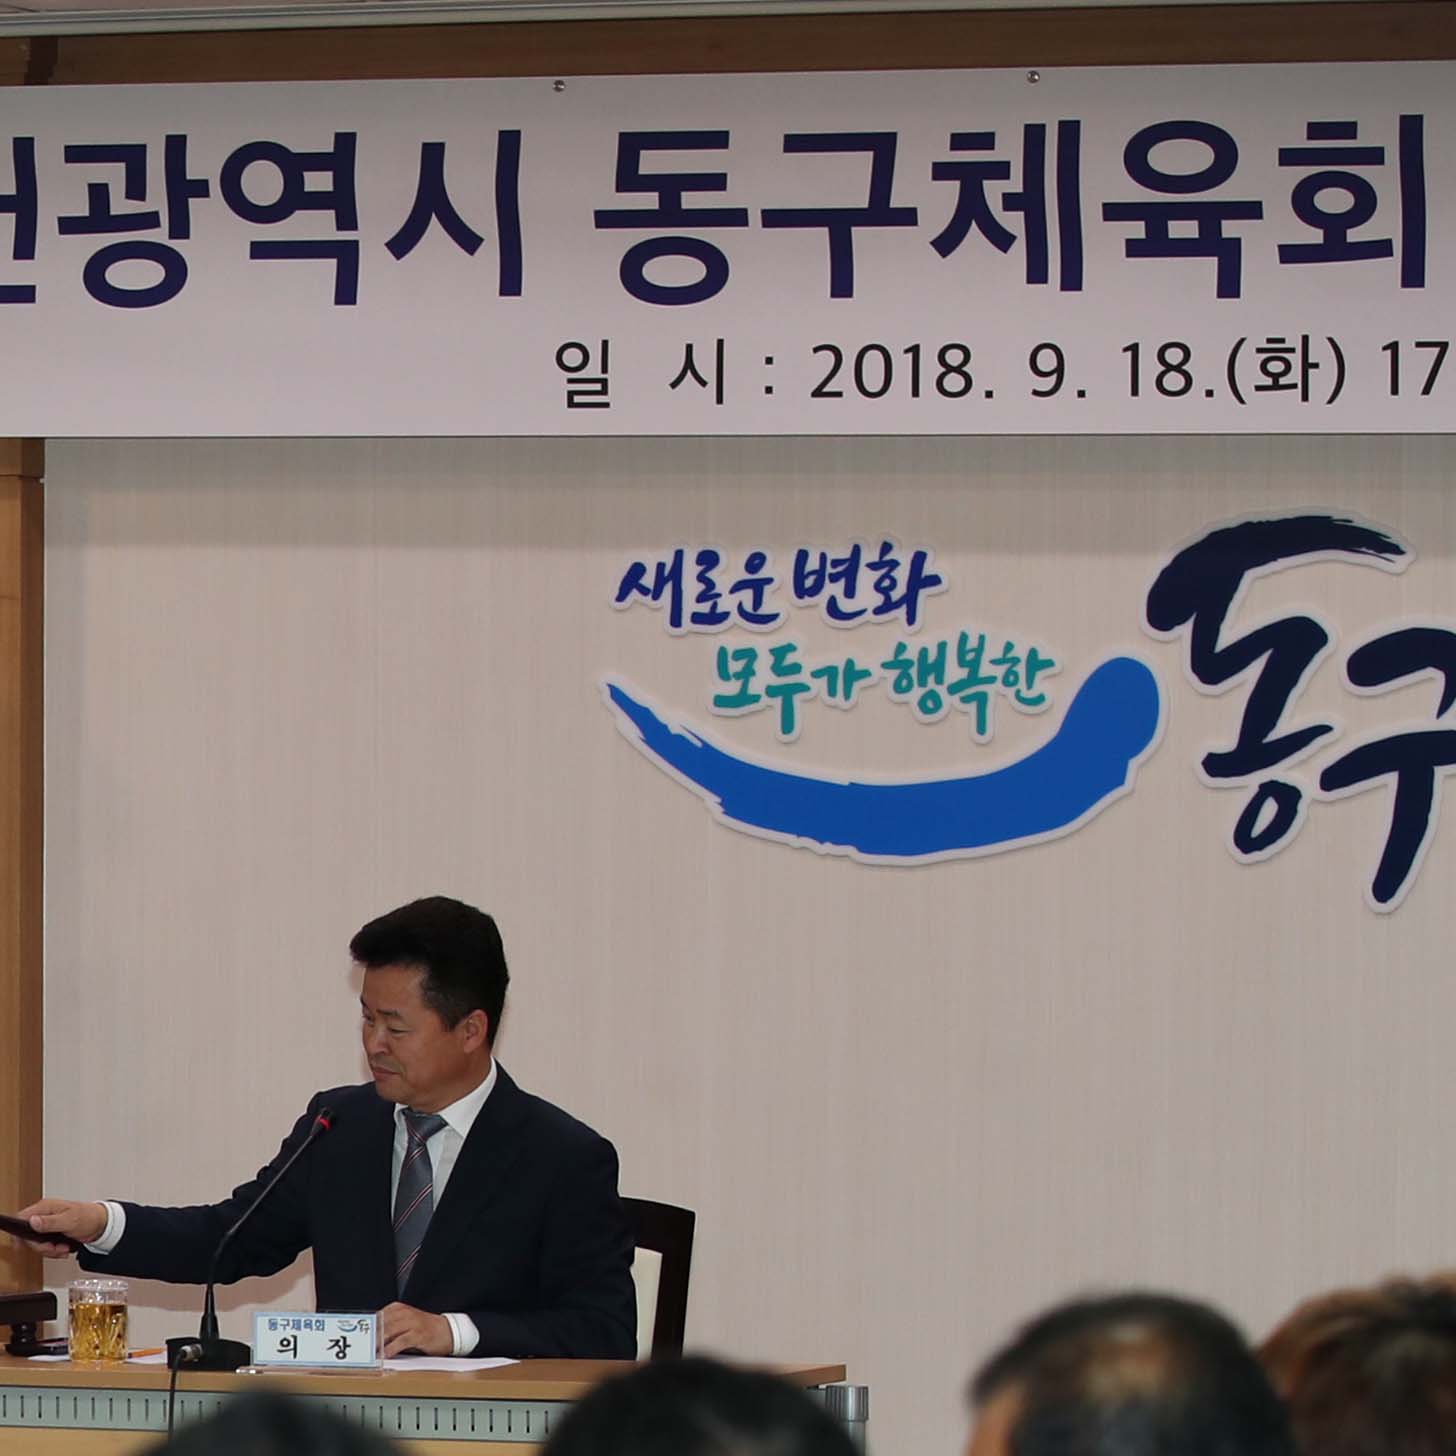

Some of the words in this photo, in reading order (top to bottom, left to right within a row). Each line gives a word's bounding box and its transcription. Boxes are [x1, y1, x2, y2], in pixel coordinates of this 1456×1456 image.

[594, 114, 1426, 305] 동구체육회
[556, 340, 610, 408] 일
[811, 344, 993, 398] 2018.
[1030, 343, 1085, 398] 9.
[1123, 335, 1345, 404] 18.(화)
[1382, 341, 1449, 395] 17
[615, 549, 779, 628] 새로운
[793, 541, 942, 626] 변화
[713, 642, 872, 736] 모두가
[881, 631, 1056, 736] 행복한
[1147, 516, 1456, 904] 동구
[267, 1318, 326, 1331] 동구체육회
[276, 1334, 298, 1359] 의
[326, 1335, 352, 1360] 장
